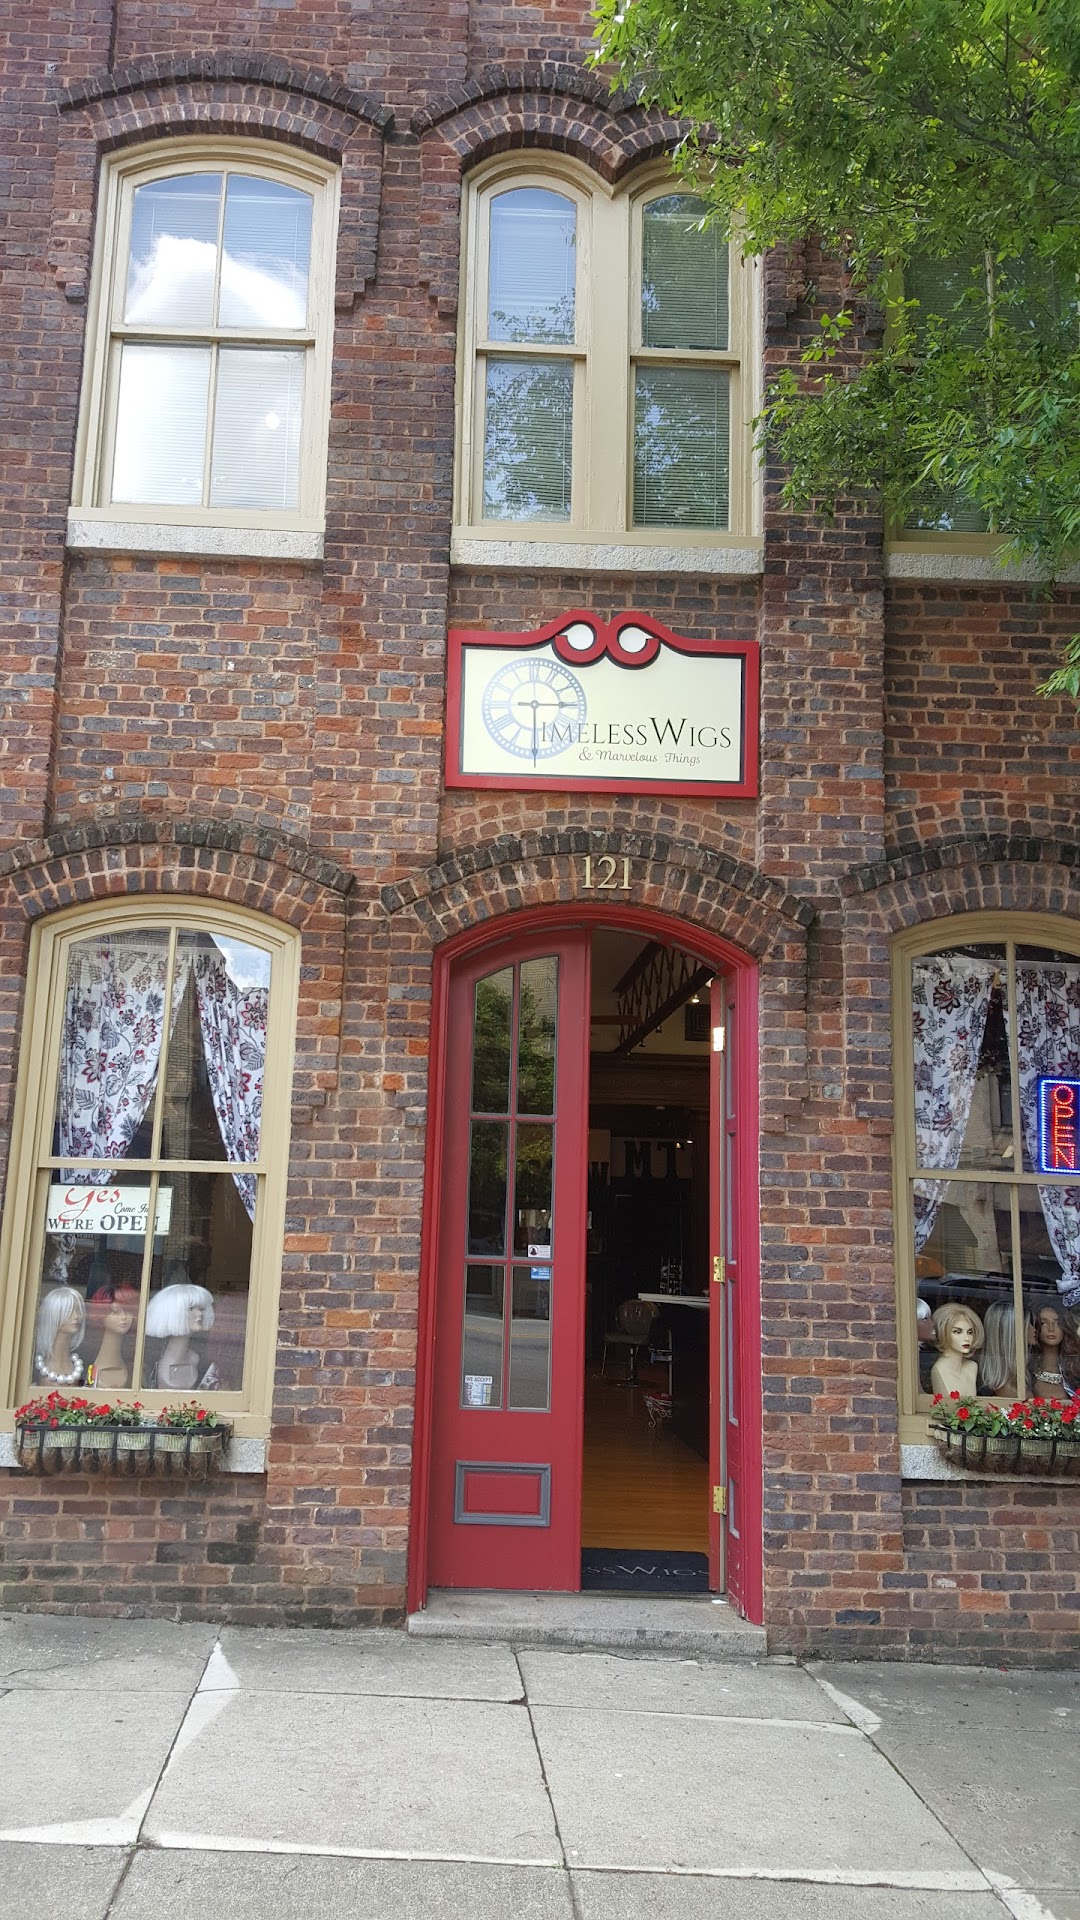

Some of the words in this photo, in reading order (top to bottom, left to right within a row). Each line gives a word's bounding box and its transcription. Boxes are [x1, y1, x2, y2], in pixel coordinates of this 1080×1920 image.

[596, 749, 658, 763] Marvelous
[664, 752, 701, 767] Things
[581, 855, 633, 890] 121
[1053, 1084, 1075, 1169] OPEN
[114, 1202, 136, 1214] Come
[48, 1218, 94, 1230] WE'RE
